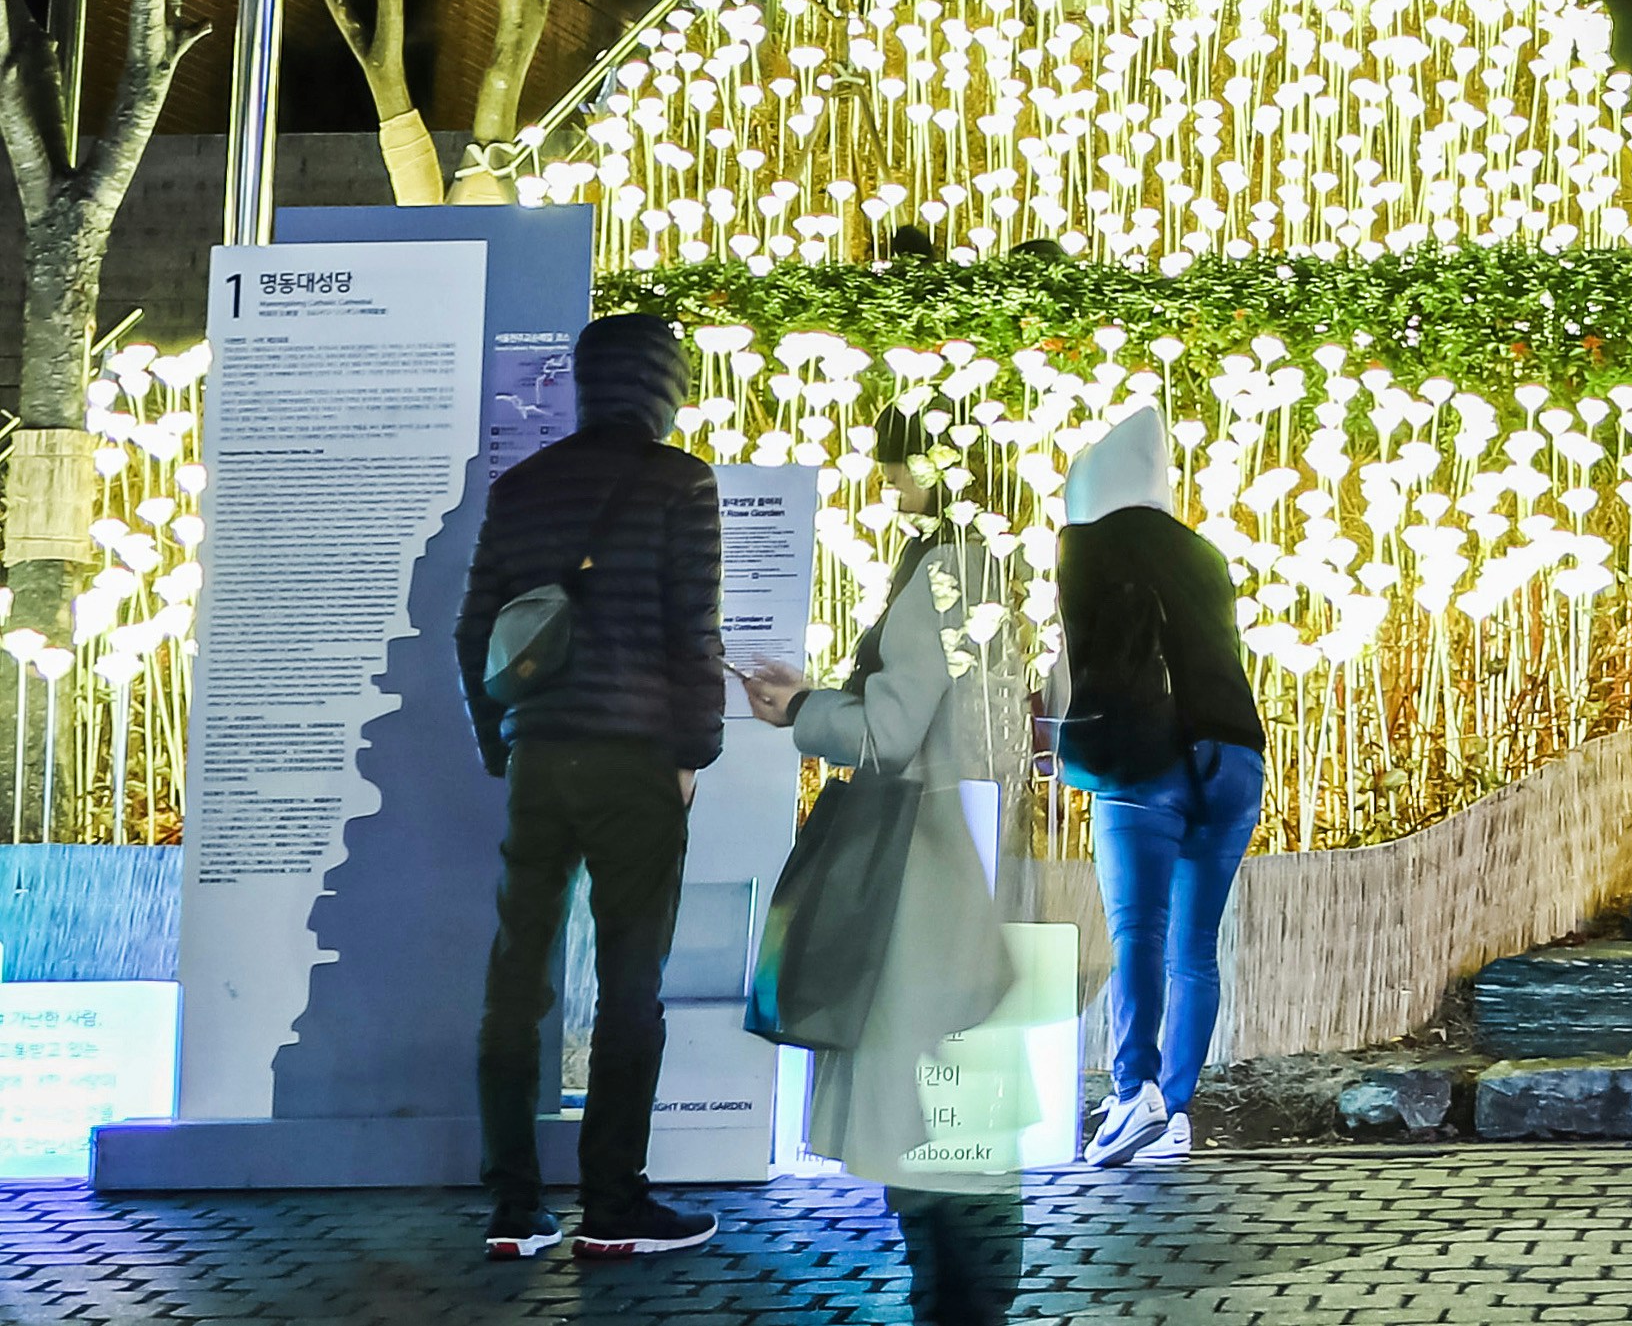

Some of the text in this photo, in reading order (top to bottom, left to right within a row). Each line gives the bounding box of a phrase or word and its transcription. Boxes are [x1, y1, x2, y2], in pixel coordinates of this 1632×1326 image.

[226, 271, 352, 319] 1 명동대성당
[751, 508, 786, 517] Garden
[654, 1101, 752, 1112] IGHT ROSE GARDEN
